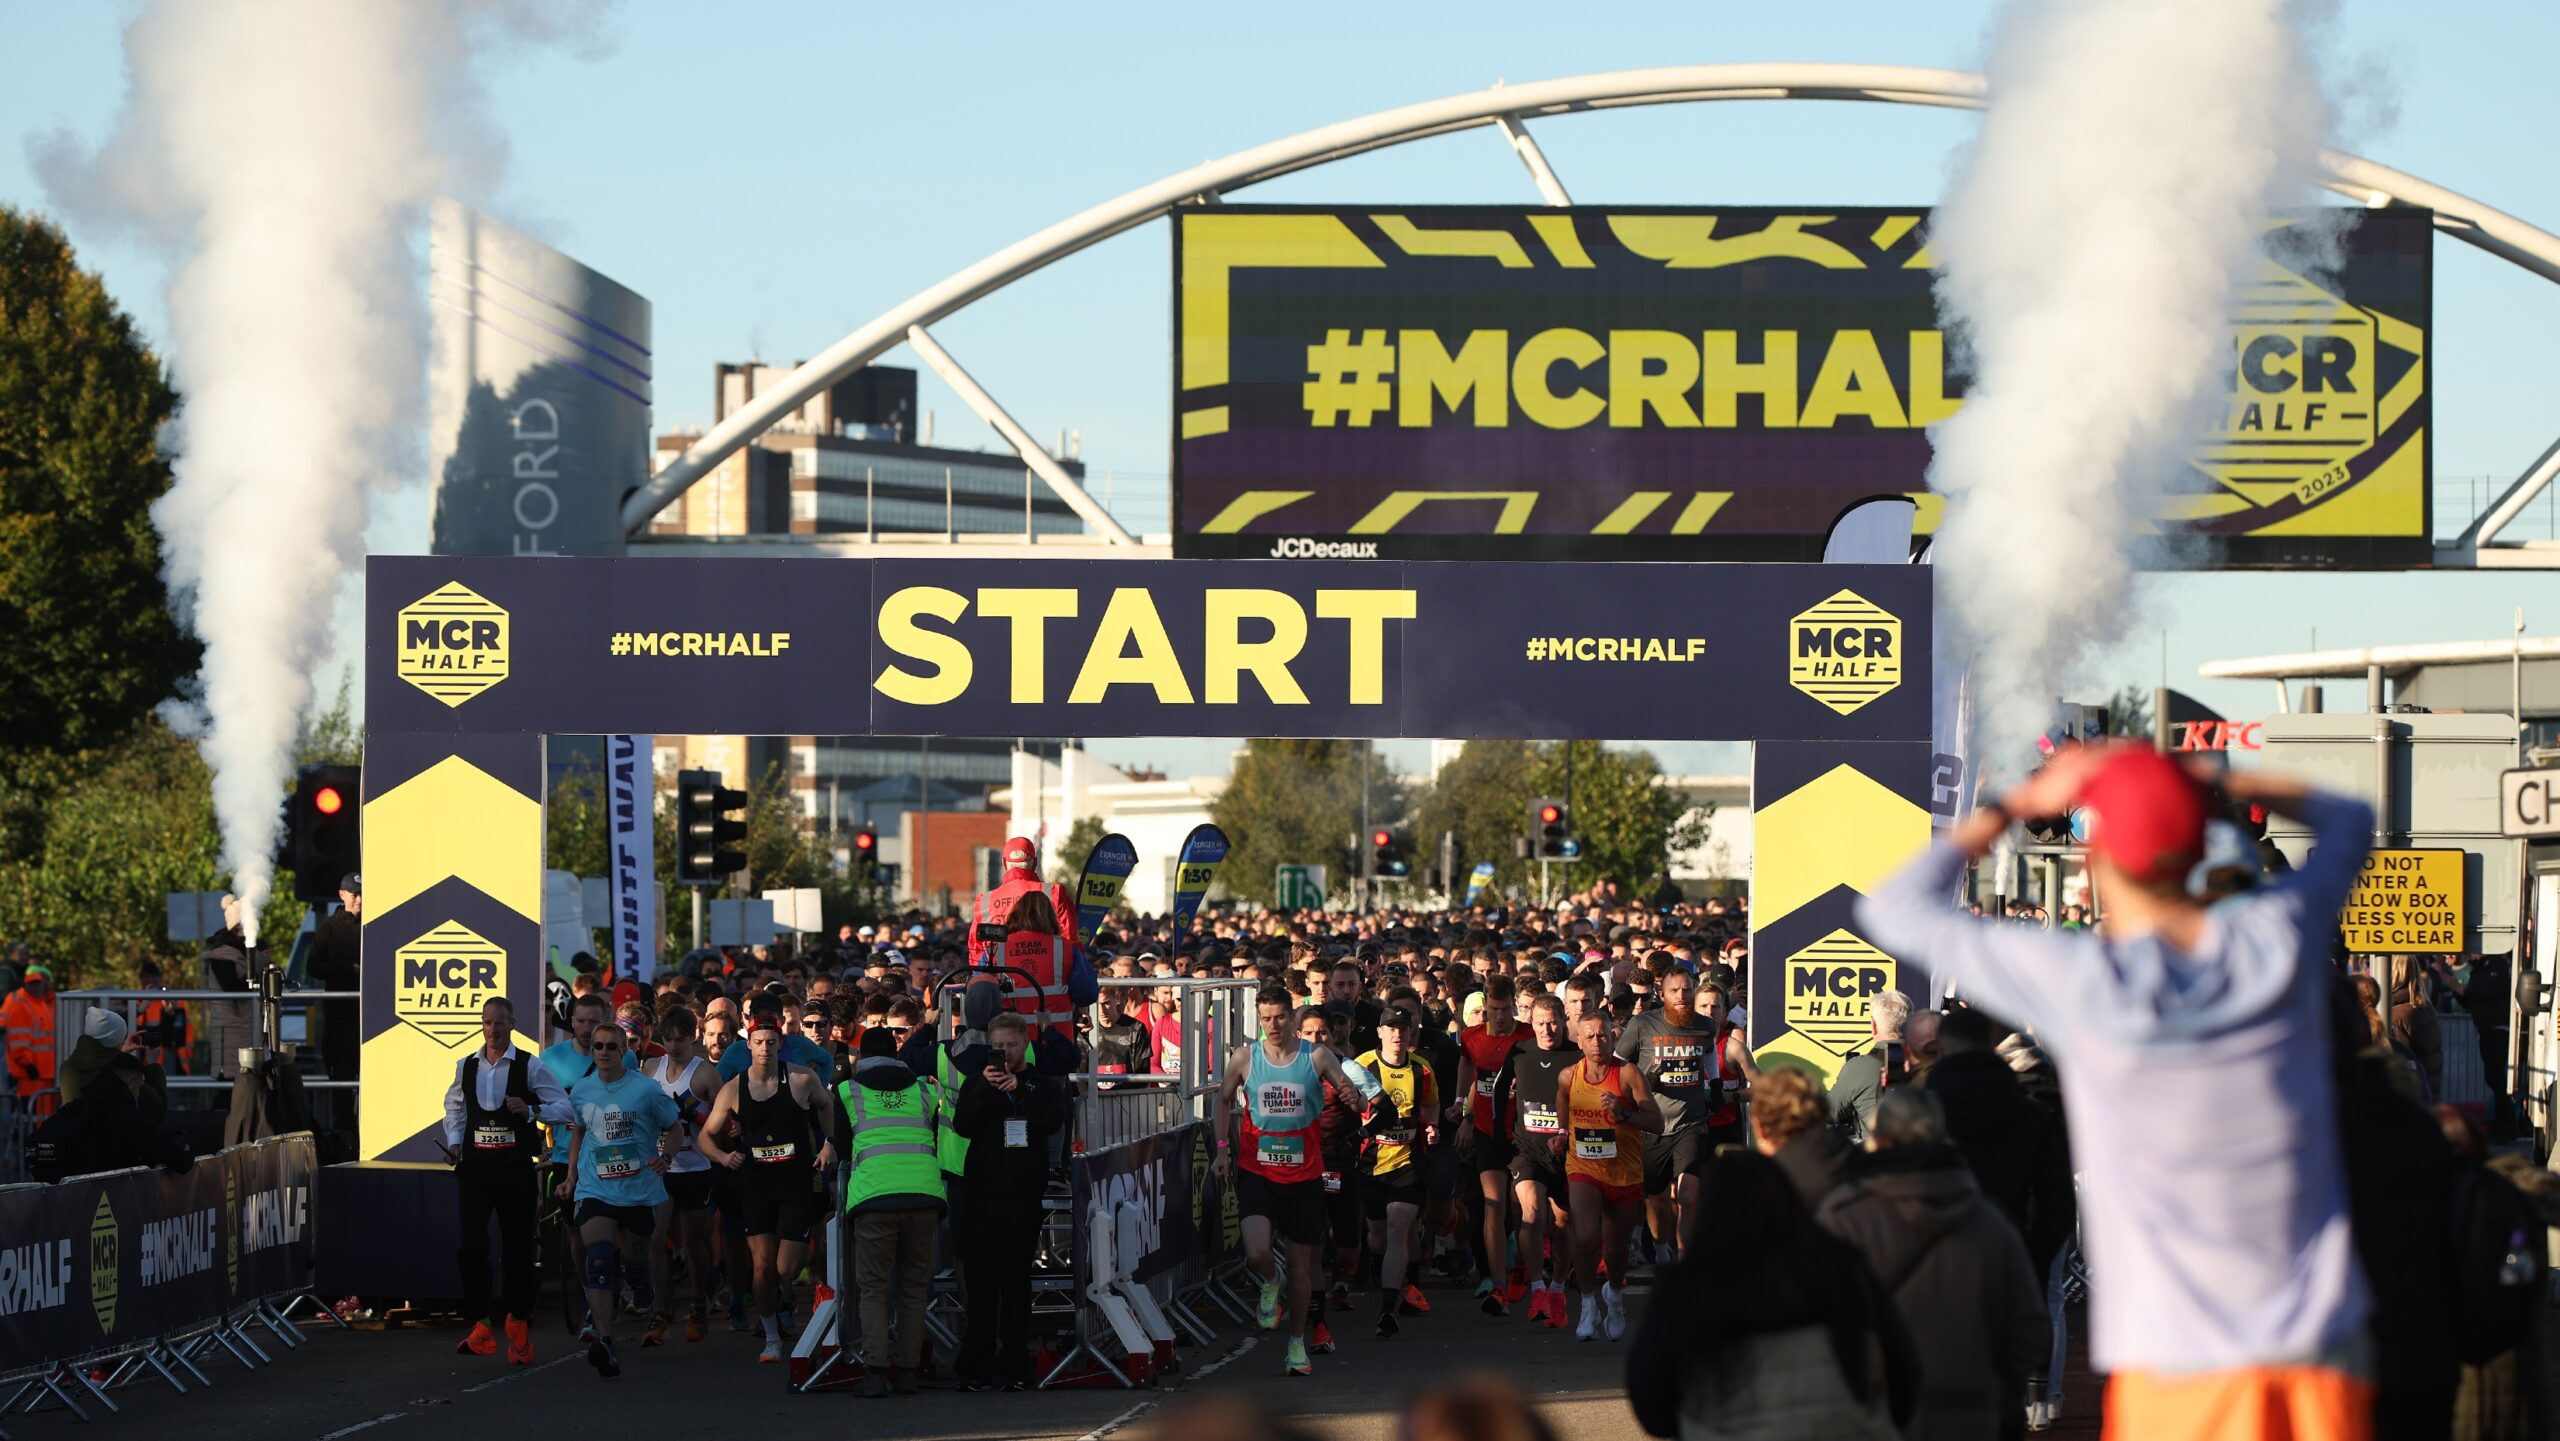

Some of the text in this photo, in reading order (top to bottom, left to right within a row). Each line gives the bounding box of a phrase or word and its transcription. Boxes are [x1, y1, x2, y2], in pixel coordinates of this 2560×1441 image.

[2230, 334, 2358, 394] CR
[1303, 327, 1966, 430] #MCRHAL
[513, 398, 559, 557] FORD
[2301, 465, 2347, 499] 2023
[1270, 537, 1378, 558] JCDecaux
[406, 619, 501, 651] MCR
[1797, 627, 1893, 658] MCR
[610, 632, 791, 657] #MCRHALF
[872, 586, 1417, 706] START
[1526, 637, 1706, 662] #MCRHALF
[421, 654, 486, 669] HALF
[1813, 661, 1878, 677] HALF
[2180, 720, 2263, 752] KFC
[2361, 856, 2424, 871] O NOT
[1183, 868, 1212, 884] 1:30
[2352, 875, 2428, 889] NTER A
[1086, 880, 1116, 898] 1:20
[2344, 893, 2449, 908] LLOW BOX
[2340, 911, 2456, 926] LESS YOUR
[2366, 929, 2384, 944] IS
[2391, 929, 2455, 944] CLEAR
[1010, 948, 1048, 957] LEADER
[1014, 941, 1042, 949] TEAM
[403, 958, 498, 989] MCR
[1793, 966, 1888, 998] MCR
[419, 993, 482, 1008] HALF
[1808, 1001, 1870, 1017] HALF
[1263, 1099, 1302, 1108] TUMOUR
[604, 1111, 637, 1122] CURE OUR
[1531, 1118, 1556, 1128] 3277
[605, 1120, 634, 1132] OVARIAN
[481, 1135, 506, 1143] 3245
[606, 1129, 633, 1141] CANCER
[761, 1148, 786, 1157] 3525
[1584, 1145, 1603, 1154] 143
[1267, 1153, 1293, 1163] 1358
[606, 1163, 631, 1173] 1503
[92, 1233, 116, 1272] MCR
[141, 1208, 216, 1287] #MCRHALF
[97, 1273, 112, 1293] HALF
